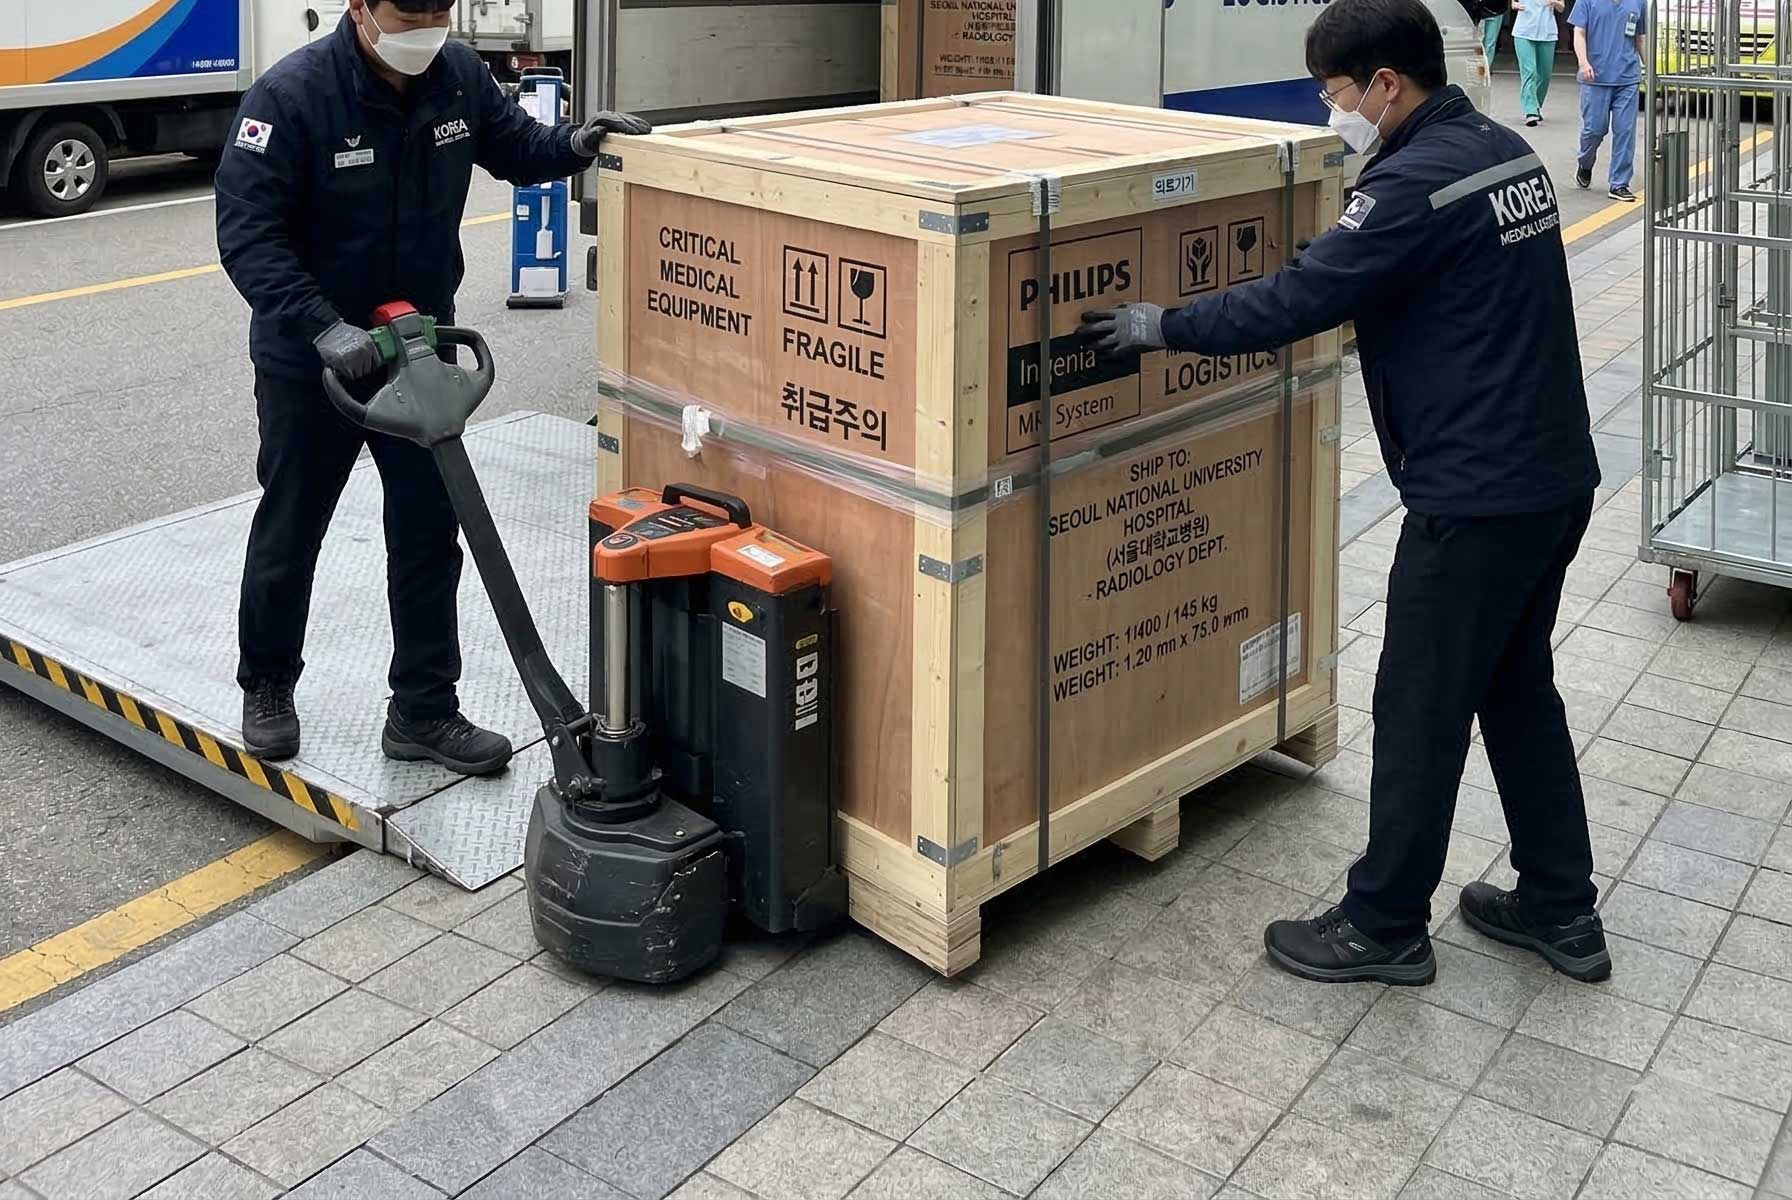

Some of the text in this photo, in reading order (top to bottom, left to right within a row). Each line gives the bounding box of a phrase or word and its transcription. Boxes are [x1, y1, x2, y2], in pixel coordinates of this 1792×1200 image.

[1488, 174, 1556, 226] KOREA
[658, 226, 741, 266] CRITICAL
[660, 258, 740, 300] MEDICAL
[647, 288, 752, 337] EQUIPMENT
[783, 327, 885, 380] FRAGILE
[780, 381, 887, 452] 취급주의
[1056, 395, 1114, 430] System
[1130, 449, 1191, 483] SHIP TO:
[1048, 448, 1263, 537] SEOUL NATIONAL UNIVERSITY
[1123, 497, 1195, 537] HOSPITAL
[1096, 535, 1228, 601] RADIOLOGY DEPT.
[1054, 633, 1120, 674] WEIGHT:
[1173, 599, 1198, 624] 145
[1201, 593, 1218, 613] kg
[1054, 660, 1120, 704] WEIGHT:
[1124, 644, 1152, 671] 1.20
[1179, 632, 1188, 649] x
[1191, 615, 1219, 642] 75.0
